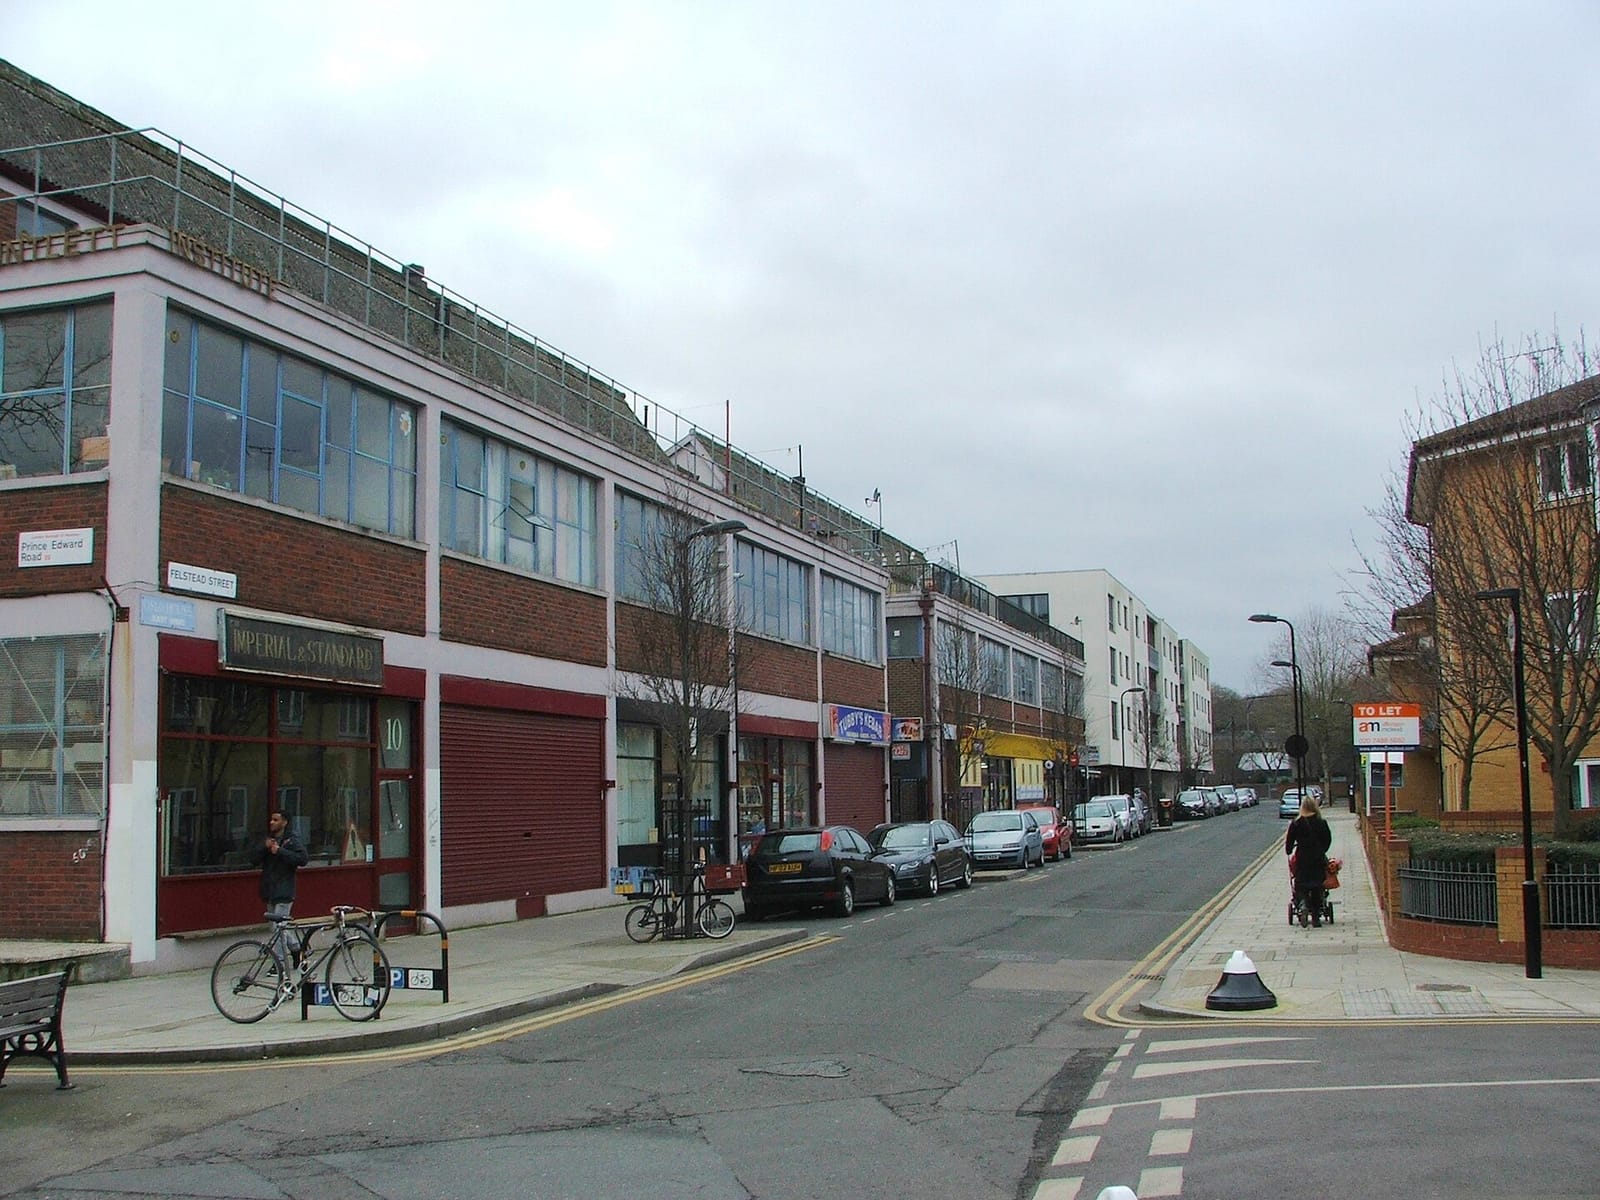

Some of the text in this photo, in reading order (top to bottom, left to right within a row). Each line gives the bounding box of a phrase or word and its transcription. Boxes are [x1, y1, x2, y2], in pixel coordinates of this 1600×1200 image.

[21, 539, 84, 551] Prince Edward
[21, 552, 42, 561] Road
[170, 569, 234, 590] FELSTEAD STREET
[233, 628, 296, 661] IMPERIAL
[307, 640, 373, 671] STANDARD
[1358, 706, 1402, 716] TO LET
[386, 718, 402, 750] 10
[391, 970, 401, 987] P
[319, 986, 331, 1002] P
